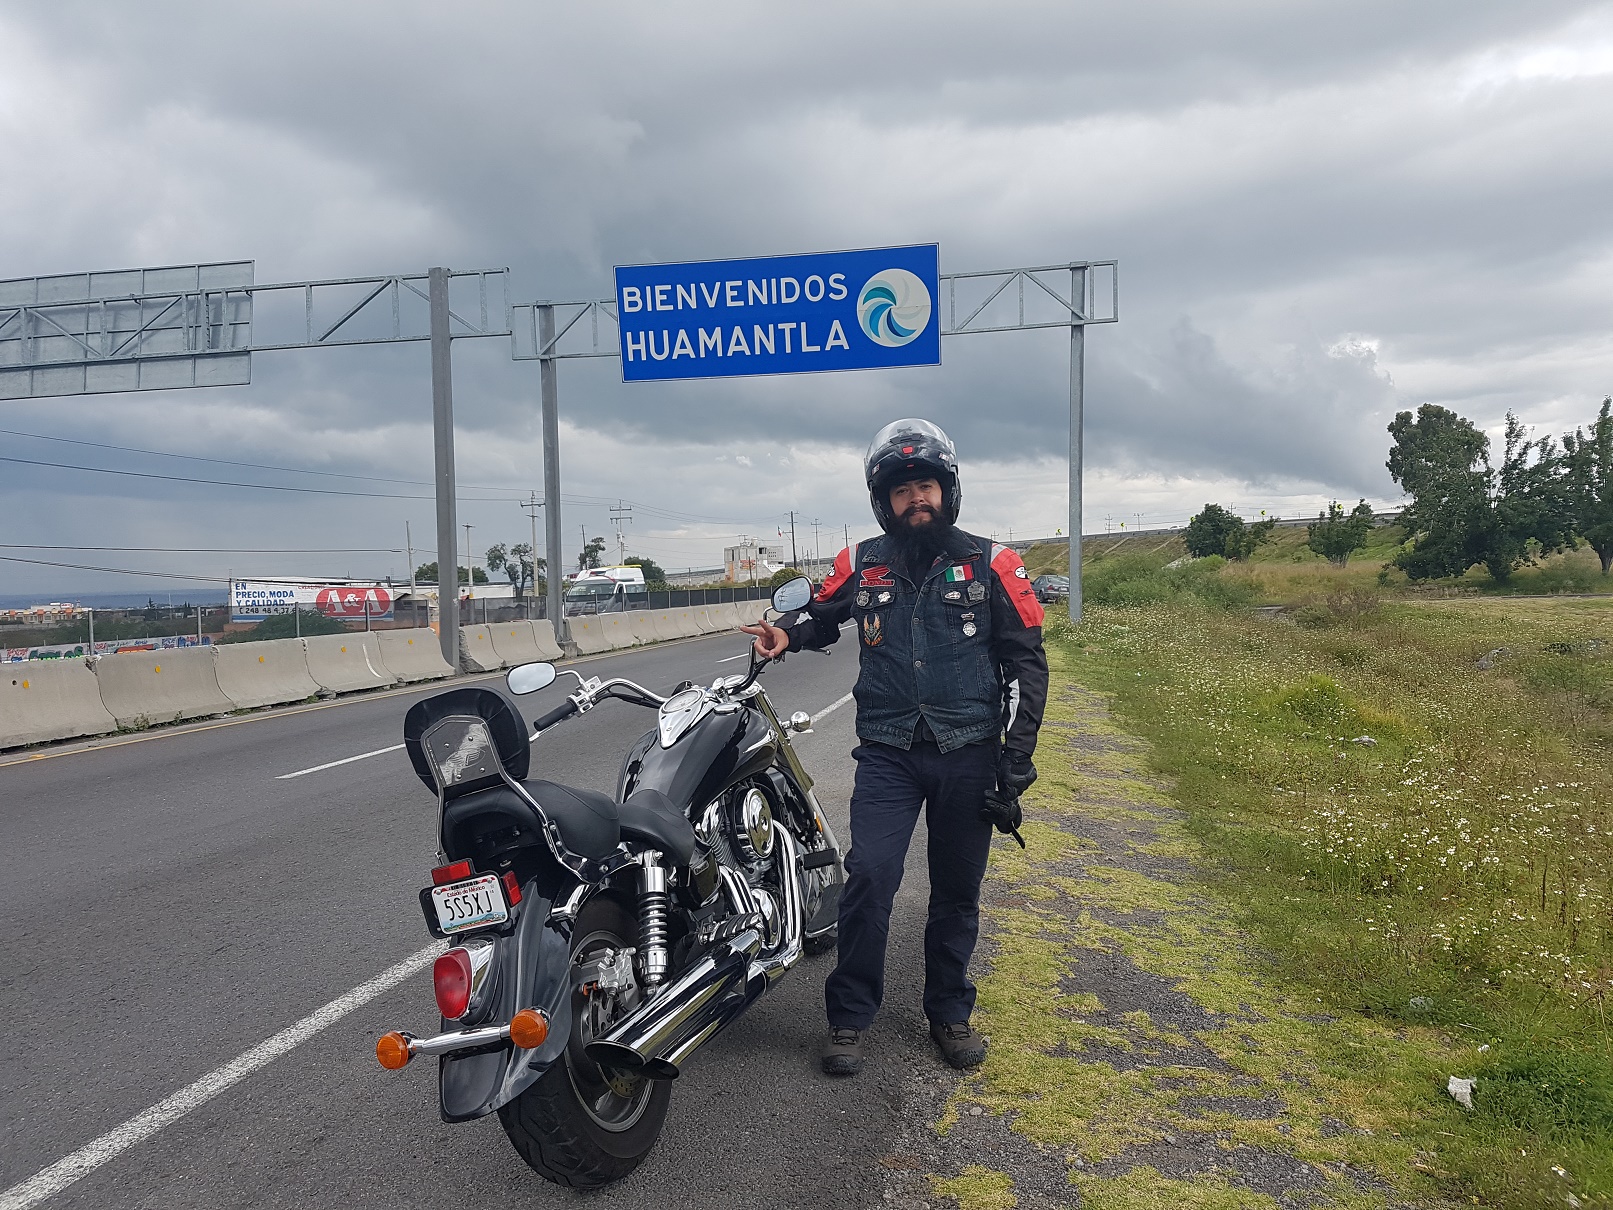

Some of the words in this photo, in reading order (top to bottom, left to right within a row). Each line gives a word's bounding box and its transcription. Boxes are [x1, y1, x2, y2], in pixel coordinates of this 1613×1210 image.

[622, 273, 848, 313] BIENVENIDOS
[626, 319, 850, 362] HUAMANTLA
[235, 582, 247, 590] EN
[236, 599, 242, 607] Y
[324, 589, 384, 613] A&A
[444, 890, 492, 921] 5S5XJ
